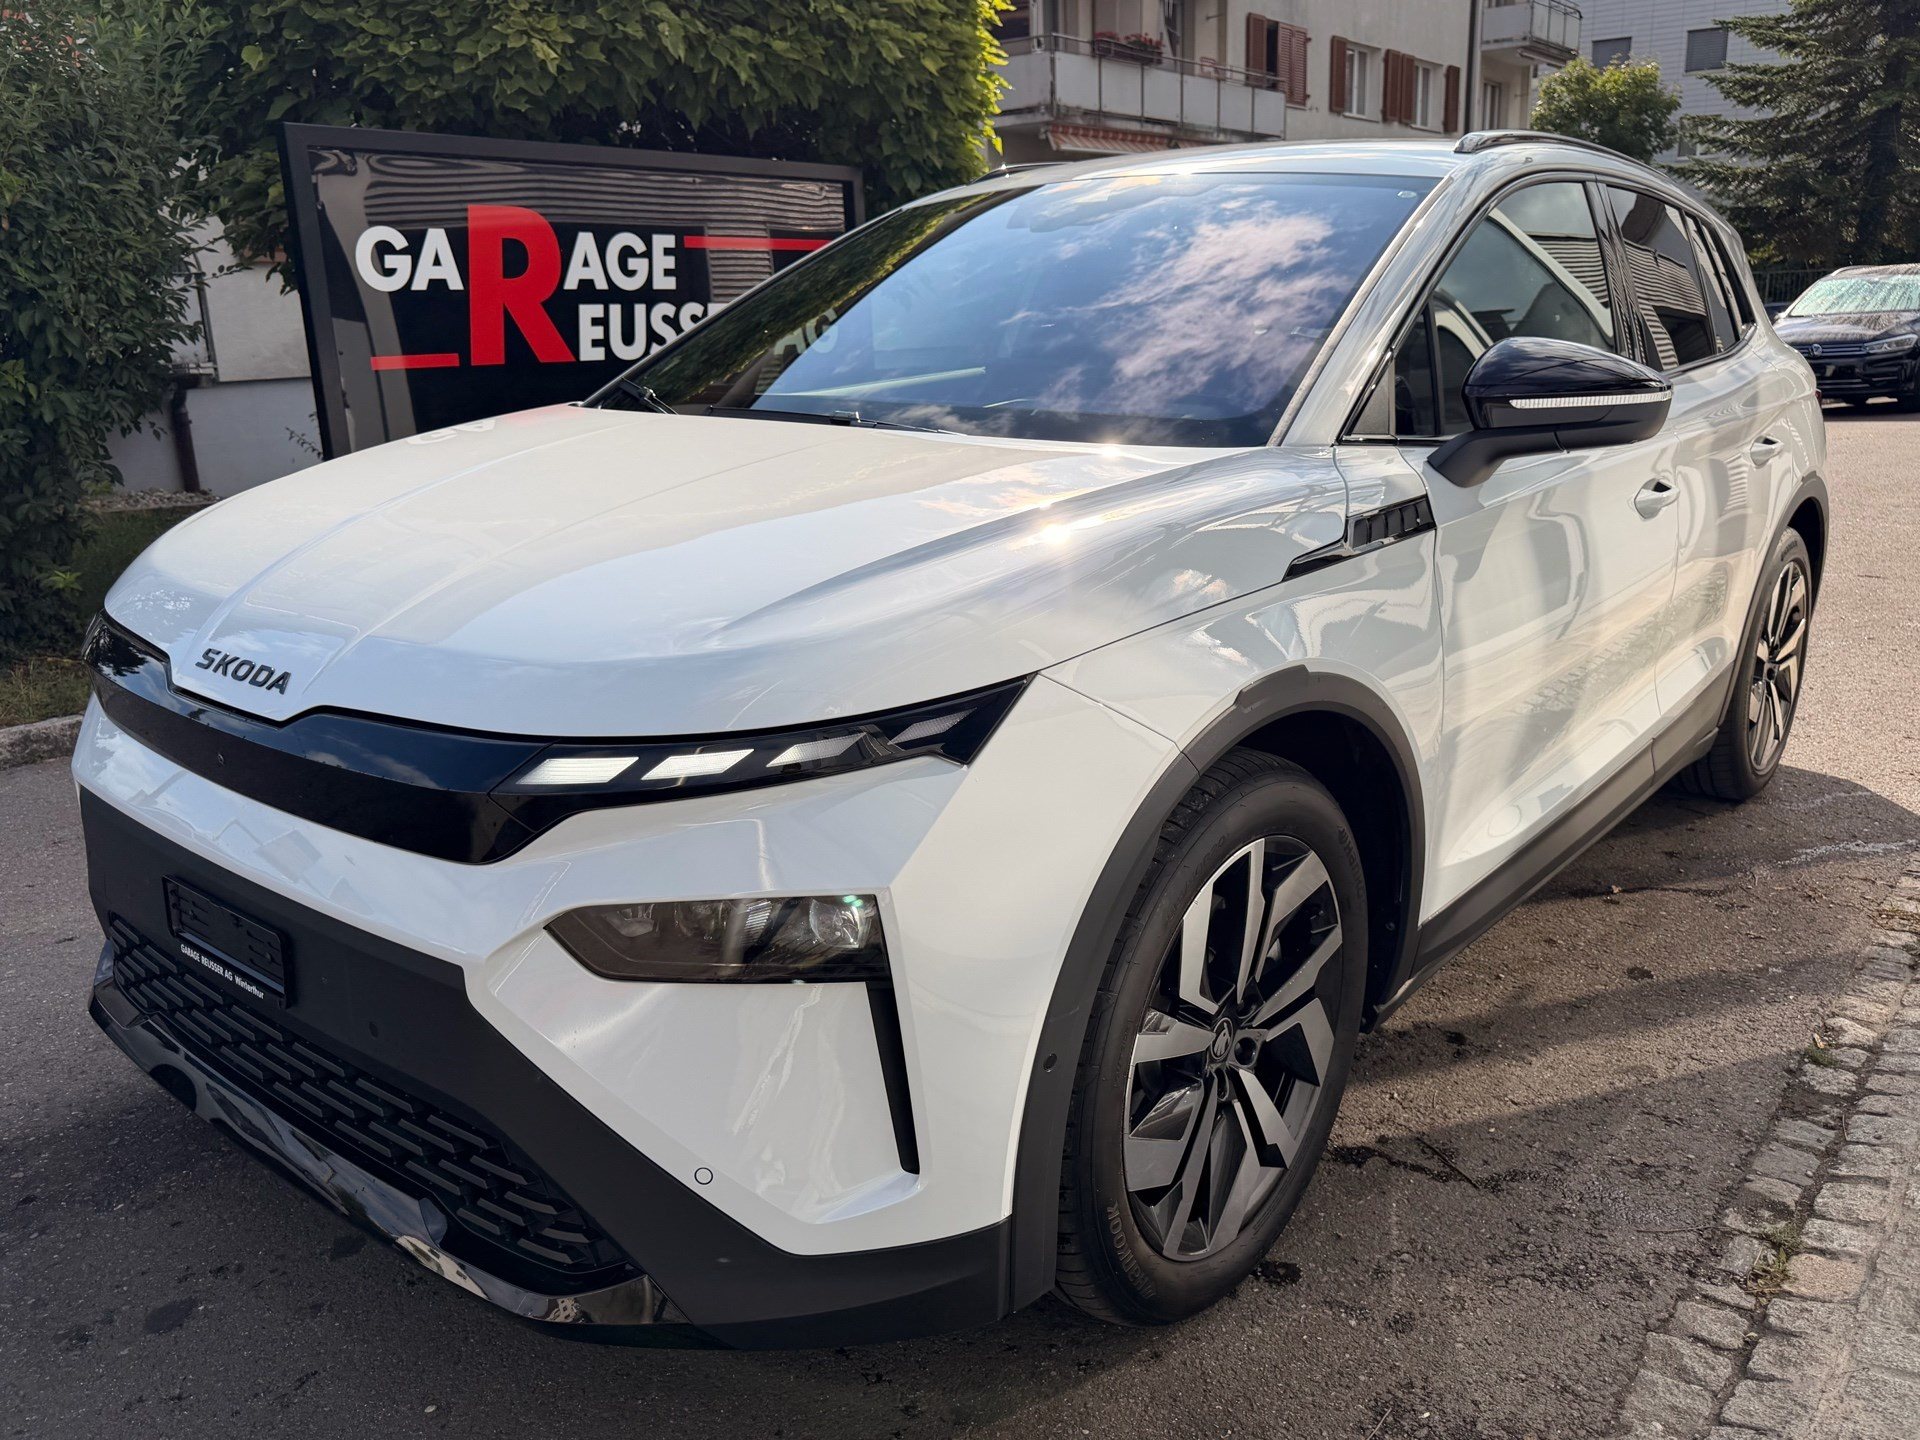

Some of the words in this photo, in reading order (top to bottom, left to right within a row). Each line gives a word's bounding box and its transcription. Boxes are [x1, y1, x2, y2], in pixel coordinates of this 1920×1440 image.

[355, 204, 677, 366] GARAGE
[180, 943, 200, 962] GARAGE
[201, 955, 224, 976] REUSSER
[225, 969, 233, 981] AG
[234, 975, 264, 999] Winterthur
